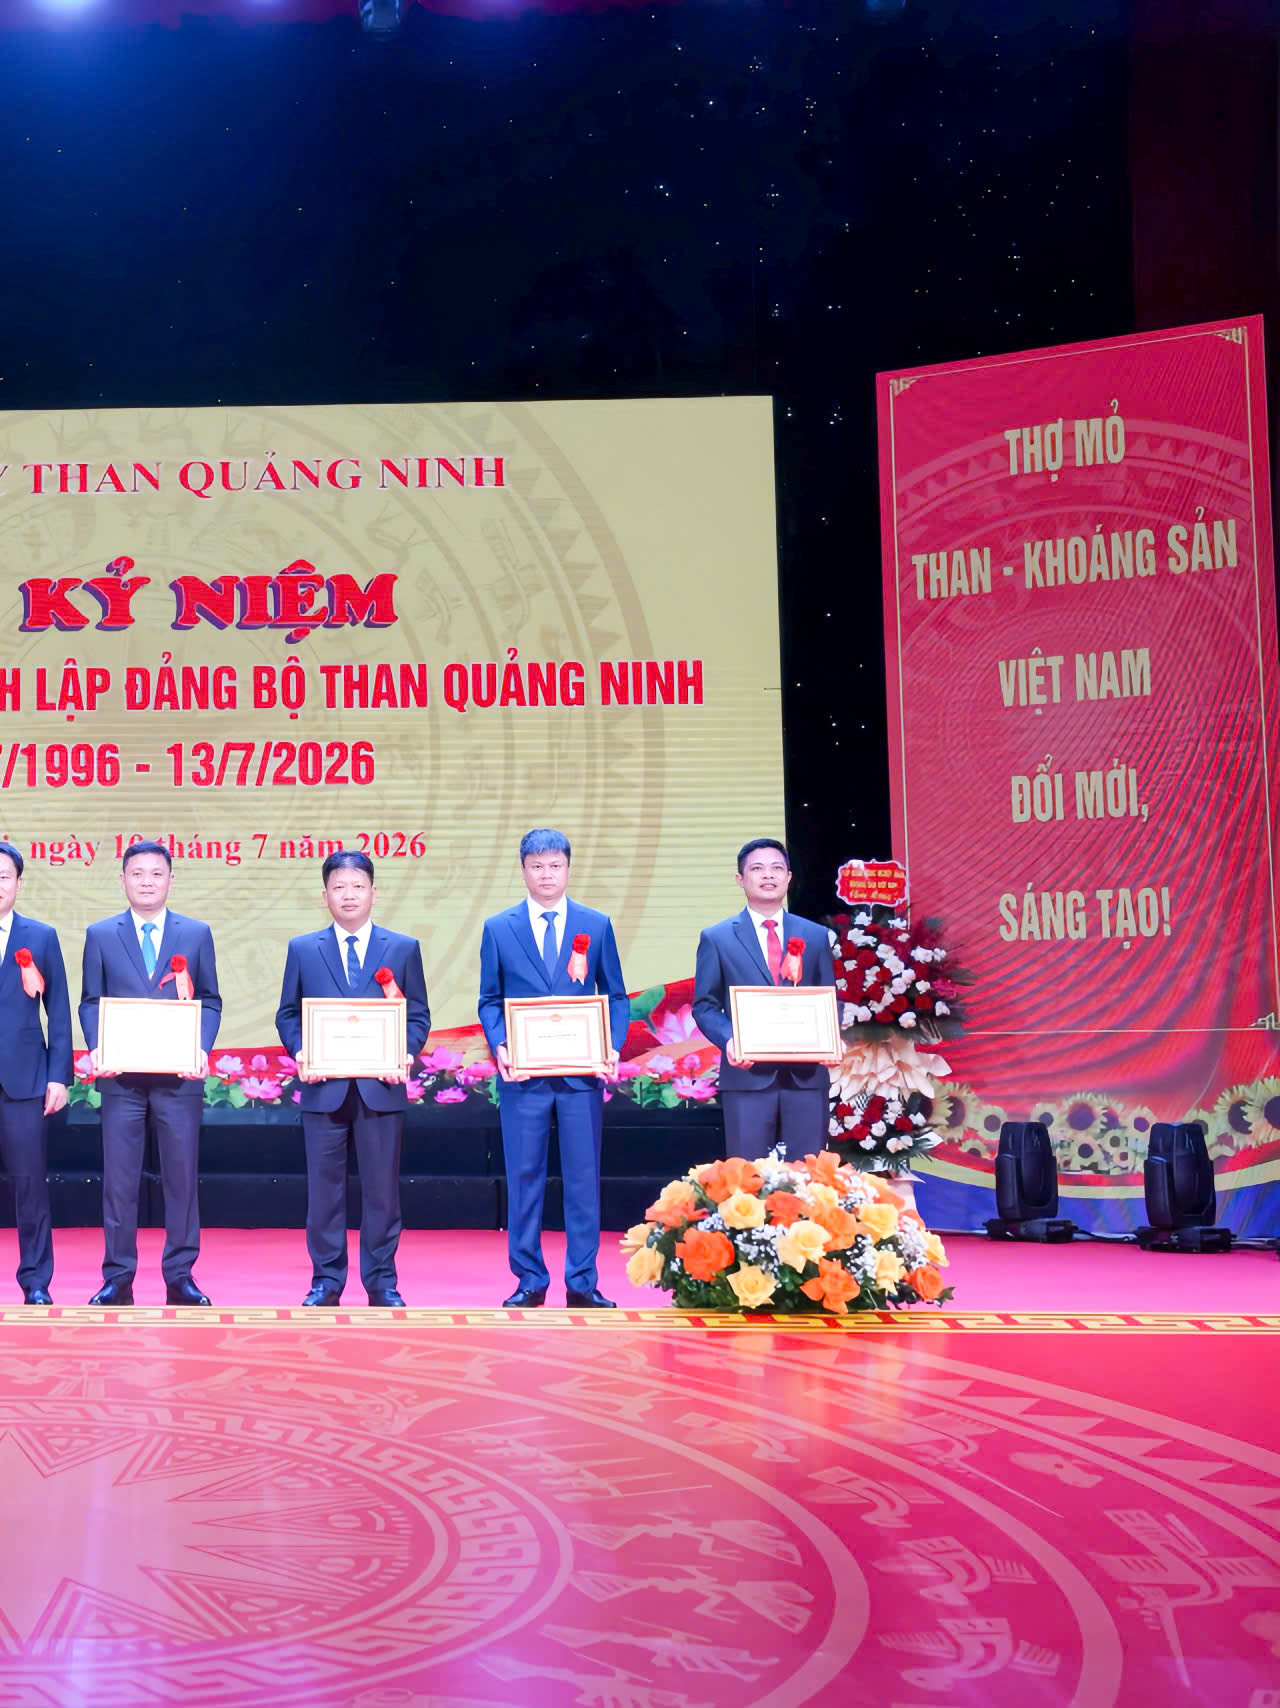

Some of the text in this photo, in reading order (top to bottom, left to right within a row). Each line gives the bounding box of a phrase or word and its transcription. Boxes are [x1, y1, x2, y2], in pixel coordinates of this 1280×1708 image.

[23, 461, 161, 495] THAN
[179, 452, 362, 499] QUẢNG
[380, 457, 506, 490] NINH
[1005, 399, 1126, 483] THỢ MỎ
[911, 547, 993, 602] THAN
[1024, 524, 1157, 590] KHOÁNG
[1167, 507, 1239, 576] SẢN
[19, 555, 153, 634] KỶ
[170, 559, 400, 645] NIỆM
[35, 657, 112, 722] LẬP
[124, 651, 238, 712] ĐẢNG
[253, 656, 307, 720] BỘ
[319, 663, 429, 711] THAN
[443, 646, 586, 715] QUẢNG
[600, 659, 705, 707] NINH
[998, 646, 1153, 716] VIỆT NAM
[165, 740, 377, 788] 13/7/2026
[1010, 753, 1150, 824] ĐỔI MỚI,
[30, 833, 101, 867] ngày
[251, 833, 269, 860] 7
[279, 834, 344, 860] năm
[356, 831, 428, 859] 2026
[998, 882, 1173, 950] SÁNG TẠO!
